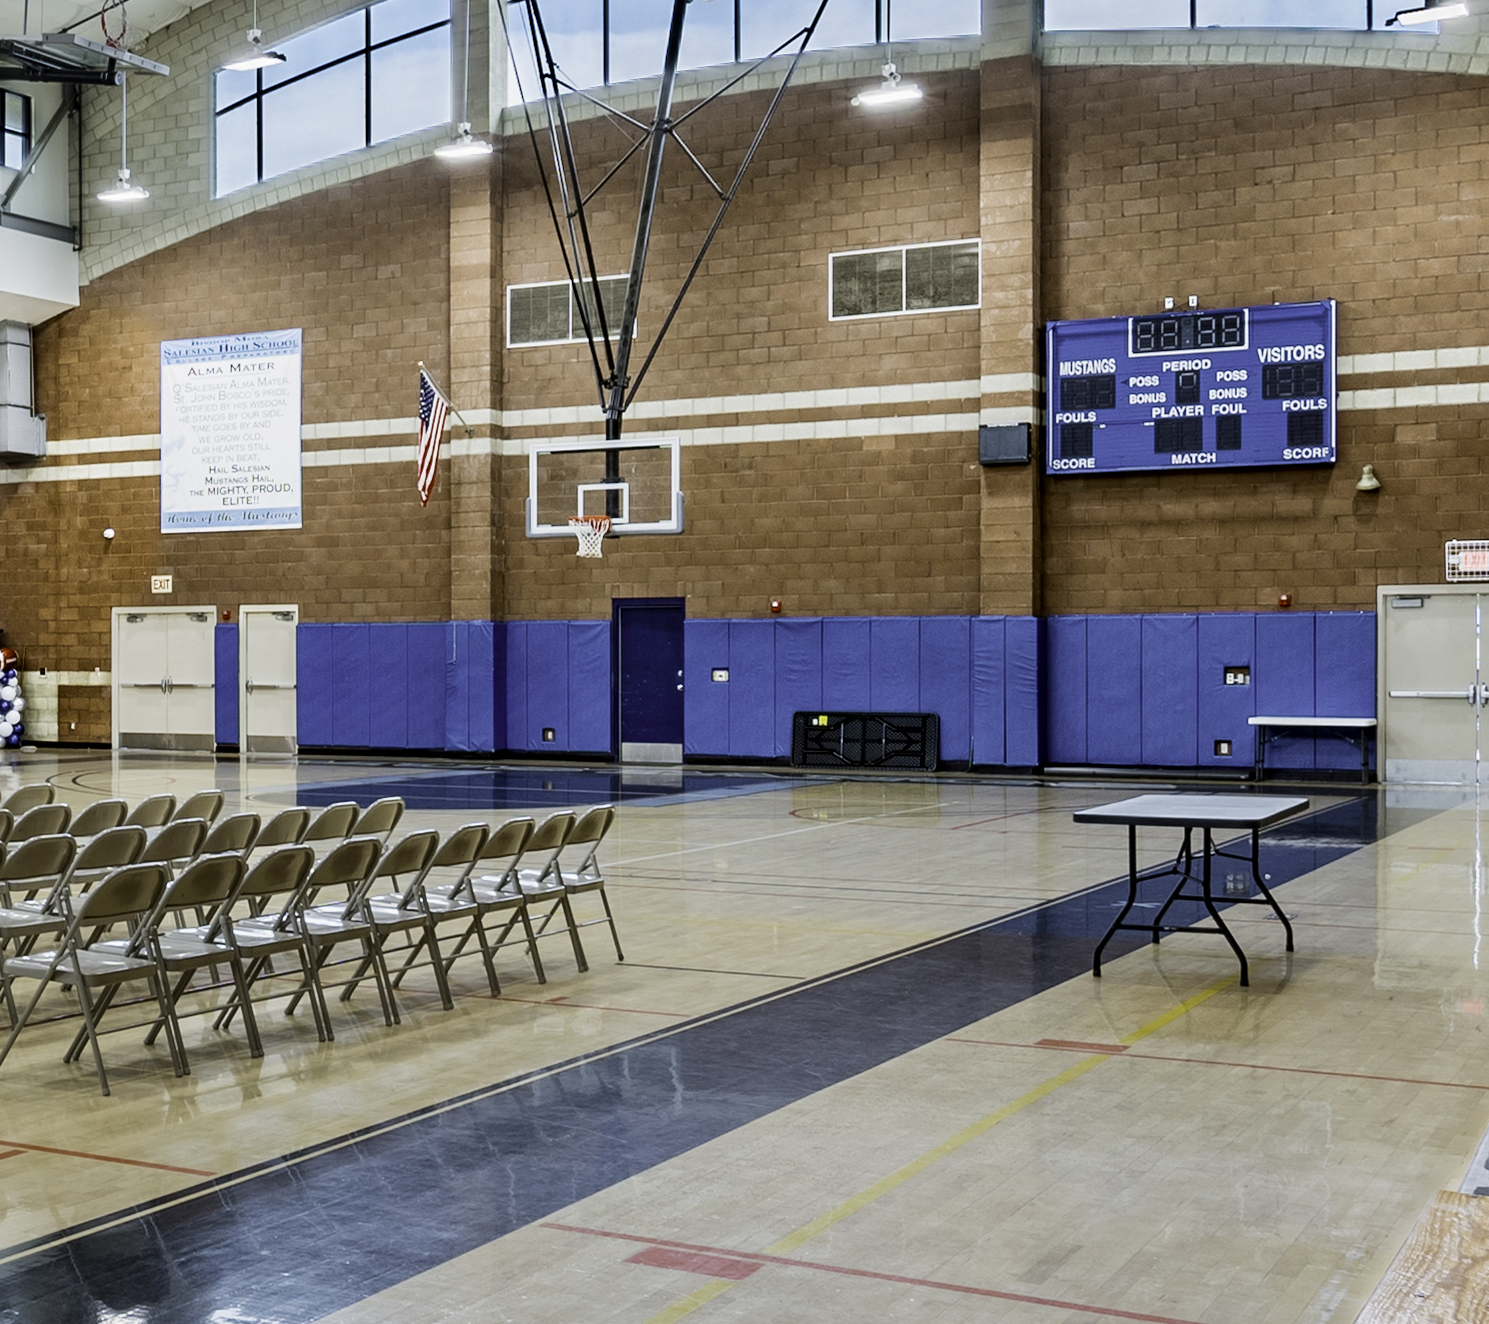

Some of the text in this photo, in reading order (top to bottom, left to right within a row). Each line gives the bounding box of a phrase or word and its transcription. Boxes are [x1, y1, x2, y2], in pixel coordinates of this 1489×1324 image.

[219, 344, 249, 353] HIGH
[253, 340, 299, 350] SCHOOL
[1257, 344, 1325, 363] VISITORS
[1059, 358, 1117, 376] MUSTANGS
[1162, 359, 1211, 372] PERIOD
[1129, 375, 1159, 388] POSS
[1216, 370, 1248, 382] POSS
[1129, 392, 1166, 405] BONUS
[1209, 387, 1247, 400] BONUS
[233, 401, 248, 409] HIS
[1151, 403, 1247, 418] PLAYER FOUL
[1282, 398, 1327, 412] FOULS
[178, 416, 190, 424] HE
[192, 413, 225, 422] STANDS
[228, 412, 238, 420] BY
[240, 411, 260, 419] OUR
[1055, 411, 1097, 424] FOULS
[191, 420, 271, 433] TIME GOES BY AND
[198, 436, 211, 444] WE
[213, 434, 240, 443] GROW
[191, 442, 271, 455] OUR HEARTS STILL
[201, 456, 223, 464] KEEP
[1052, 457, 1096, 470] SCORE
[1171, 452, 1216, 464] MATCH
[222, 496, 260, 506] ELITE!!
[153, 579, 170, 590] EXIT
